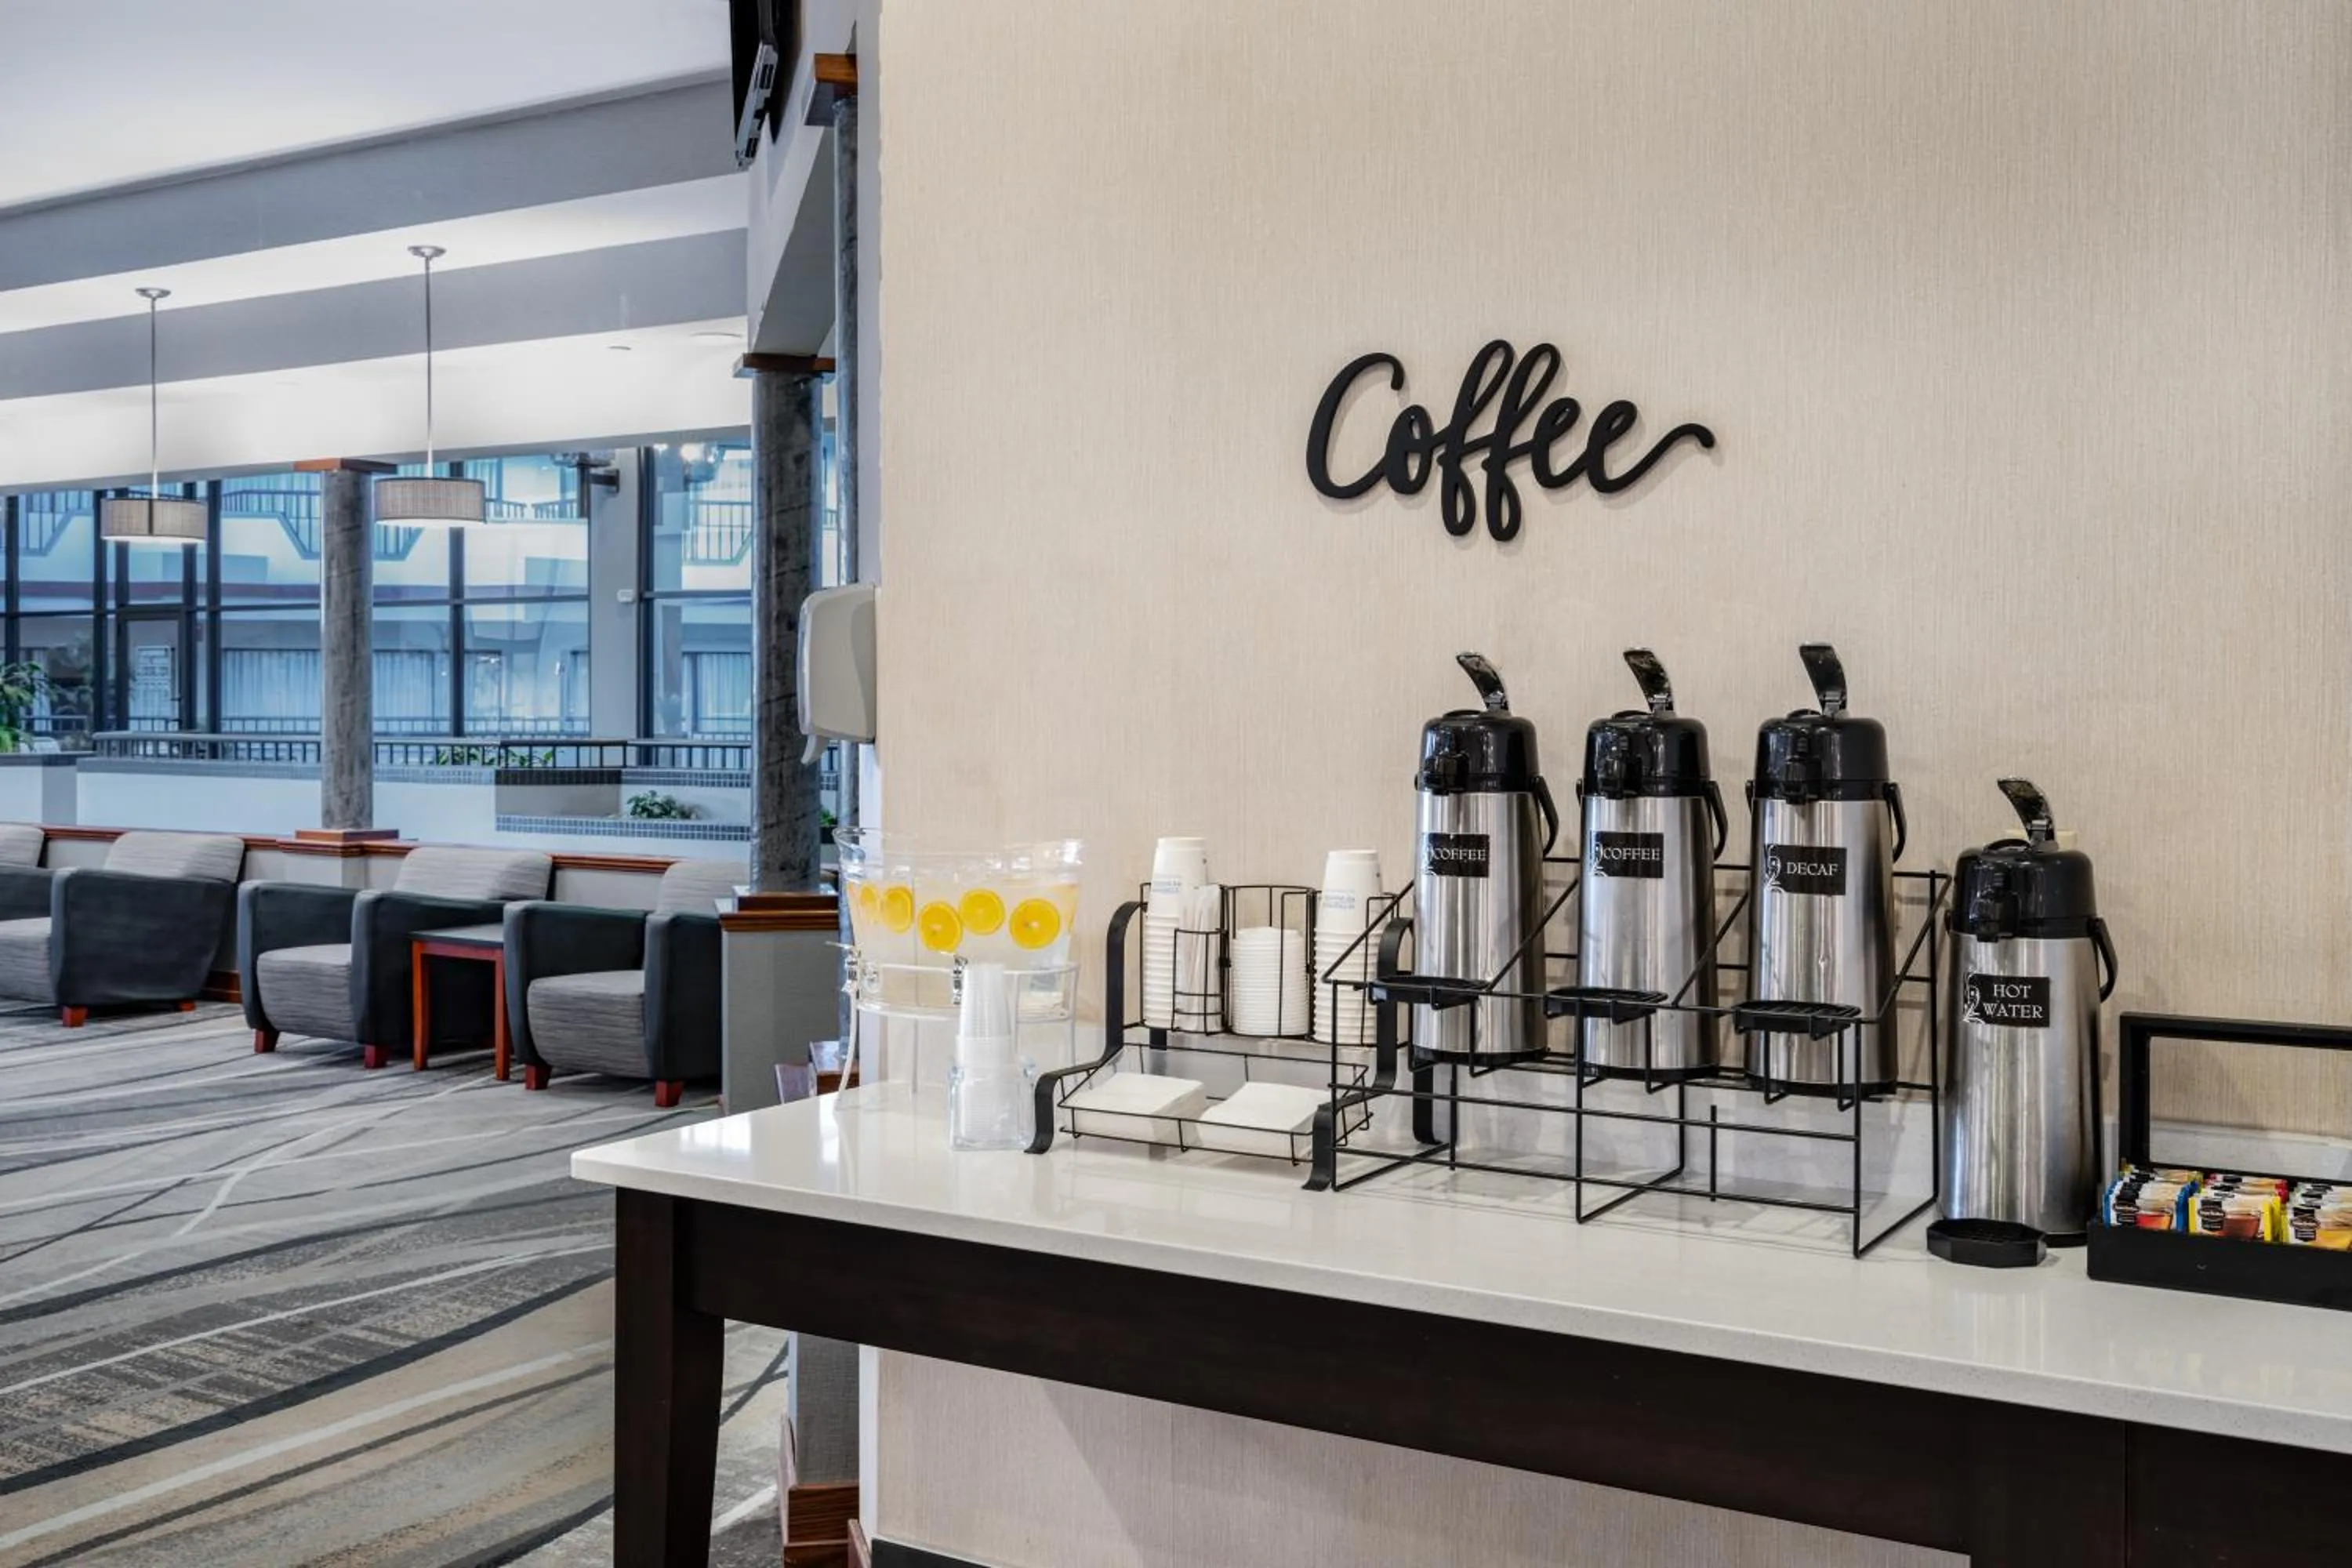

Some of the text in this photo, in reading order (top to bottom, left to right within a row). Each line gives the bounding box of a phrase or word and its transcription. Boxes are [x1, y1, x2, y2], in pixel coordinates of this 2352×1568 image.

[1306, 339, 1715, 542] Coffee
[1433, 848, 1486, 861] COFFEE
[1603, 848, 1661, 861] COFFEE
[1786, 862, 1839, 876] DECAF
[1993, 984, 2032, 999] HOT
[1982, 1003, 2044, 1018] WATER
